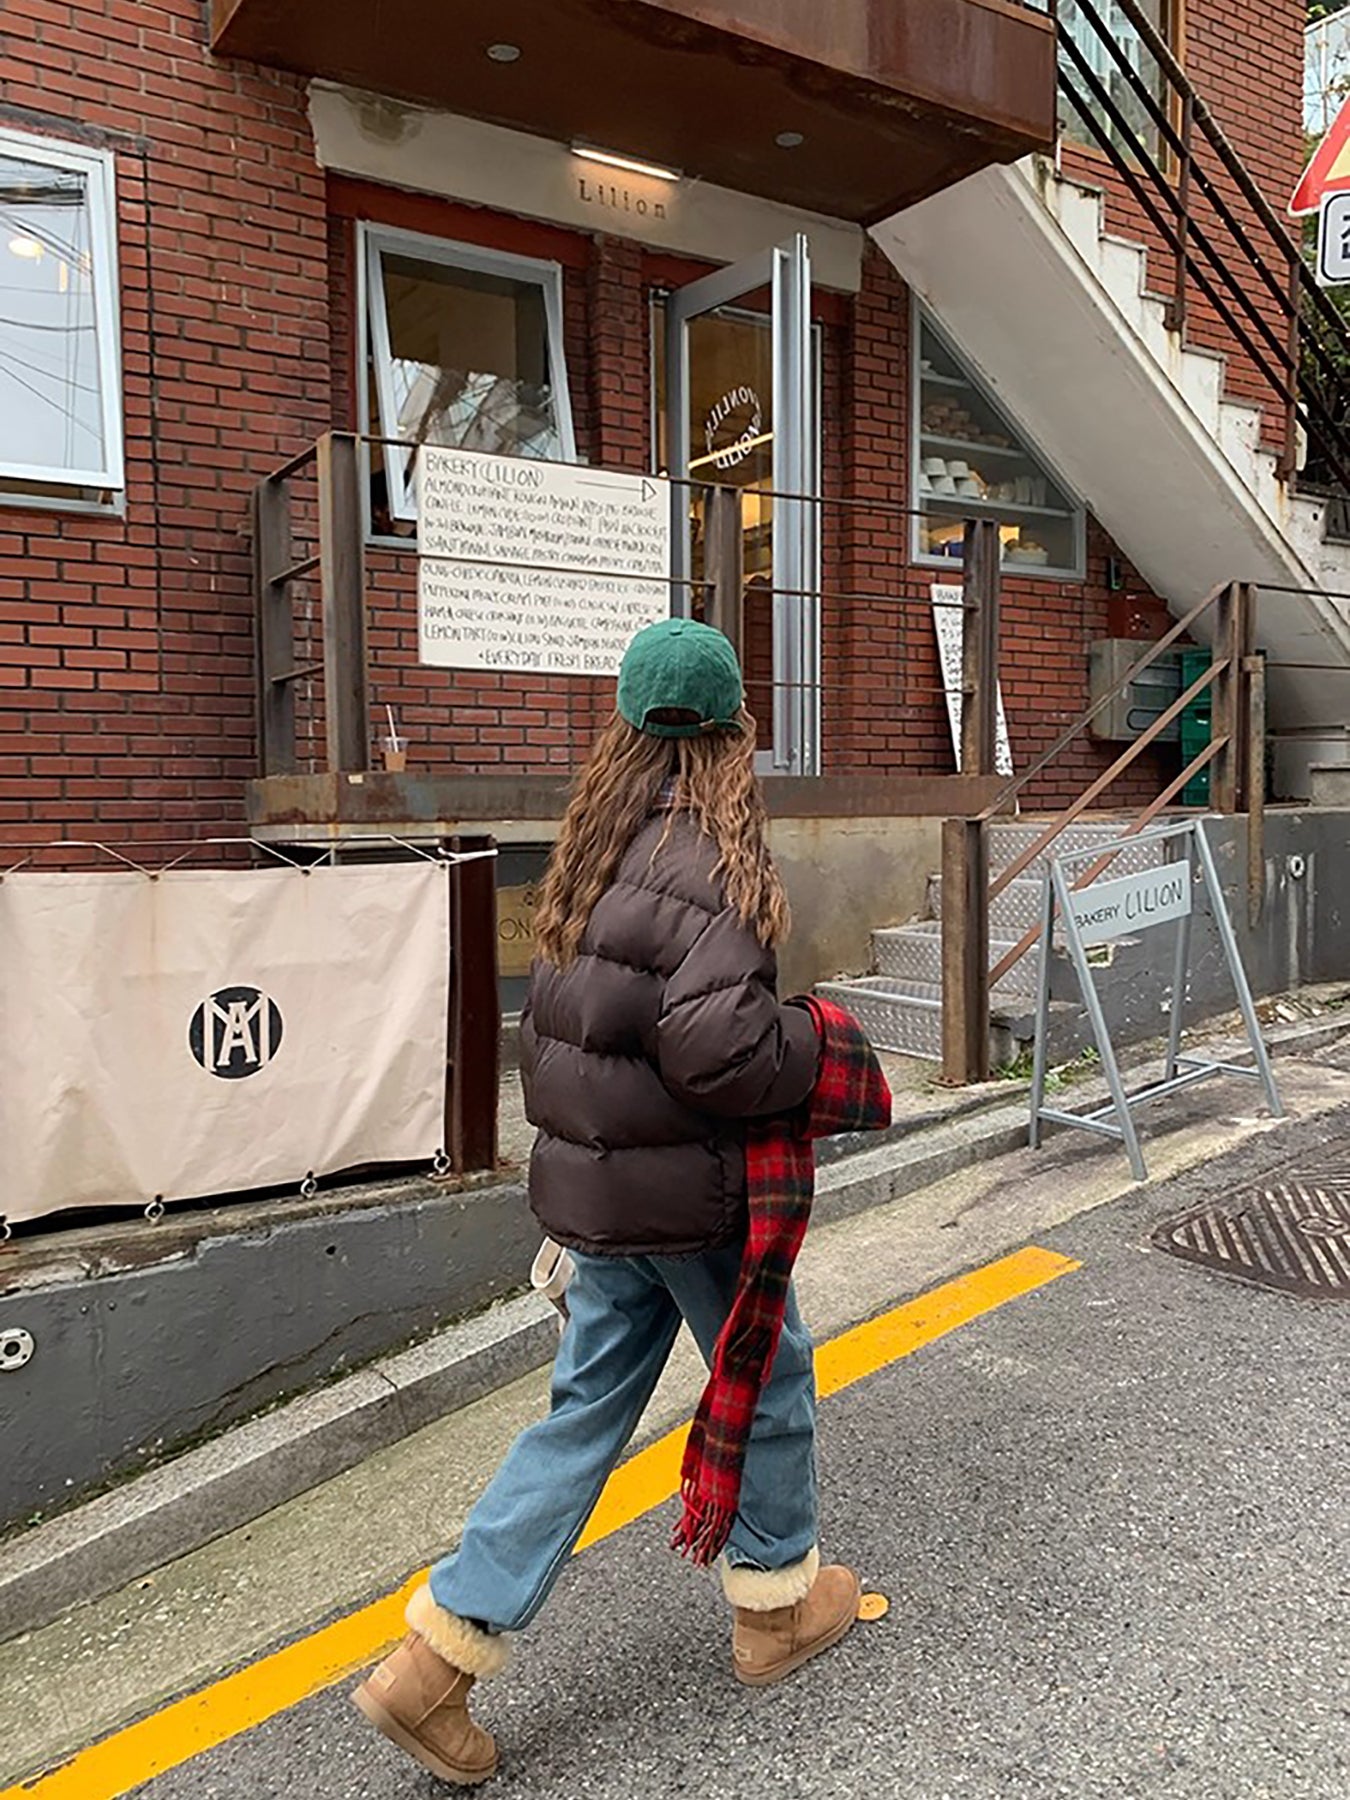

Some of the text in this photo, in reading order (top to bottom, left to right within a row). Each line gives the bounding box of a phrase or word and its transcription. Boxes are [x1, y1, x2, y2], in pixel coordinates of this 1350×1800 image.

[579, 178, 666, 219] Lilion
[426, 452, 478, 479] BAKERY
[1074, 878, 1182, 930] BAKERY LILION
